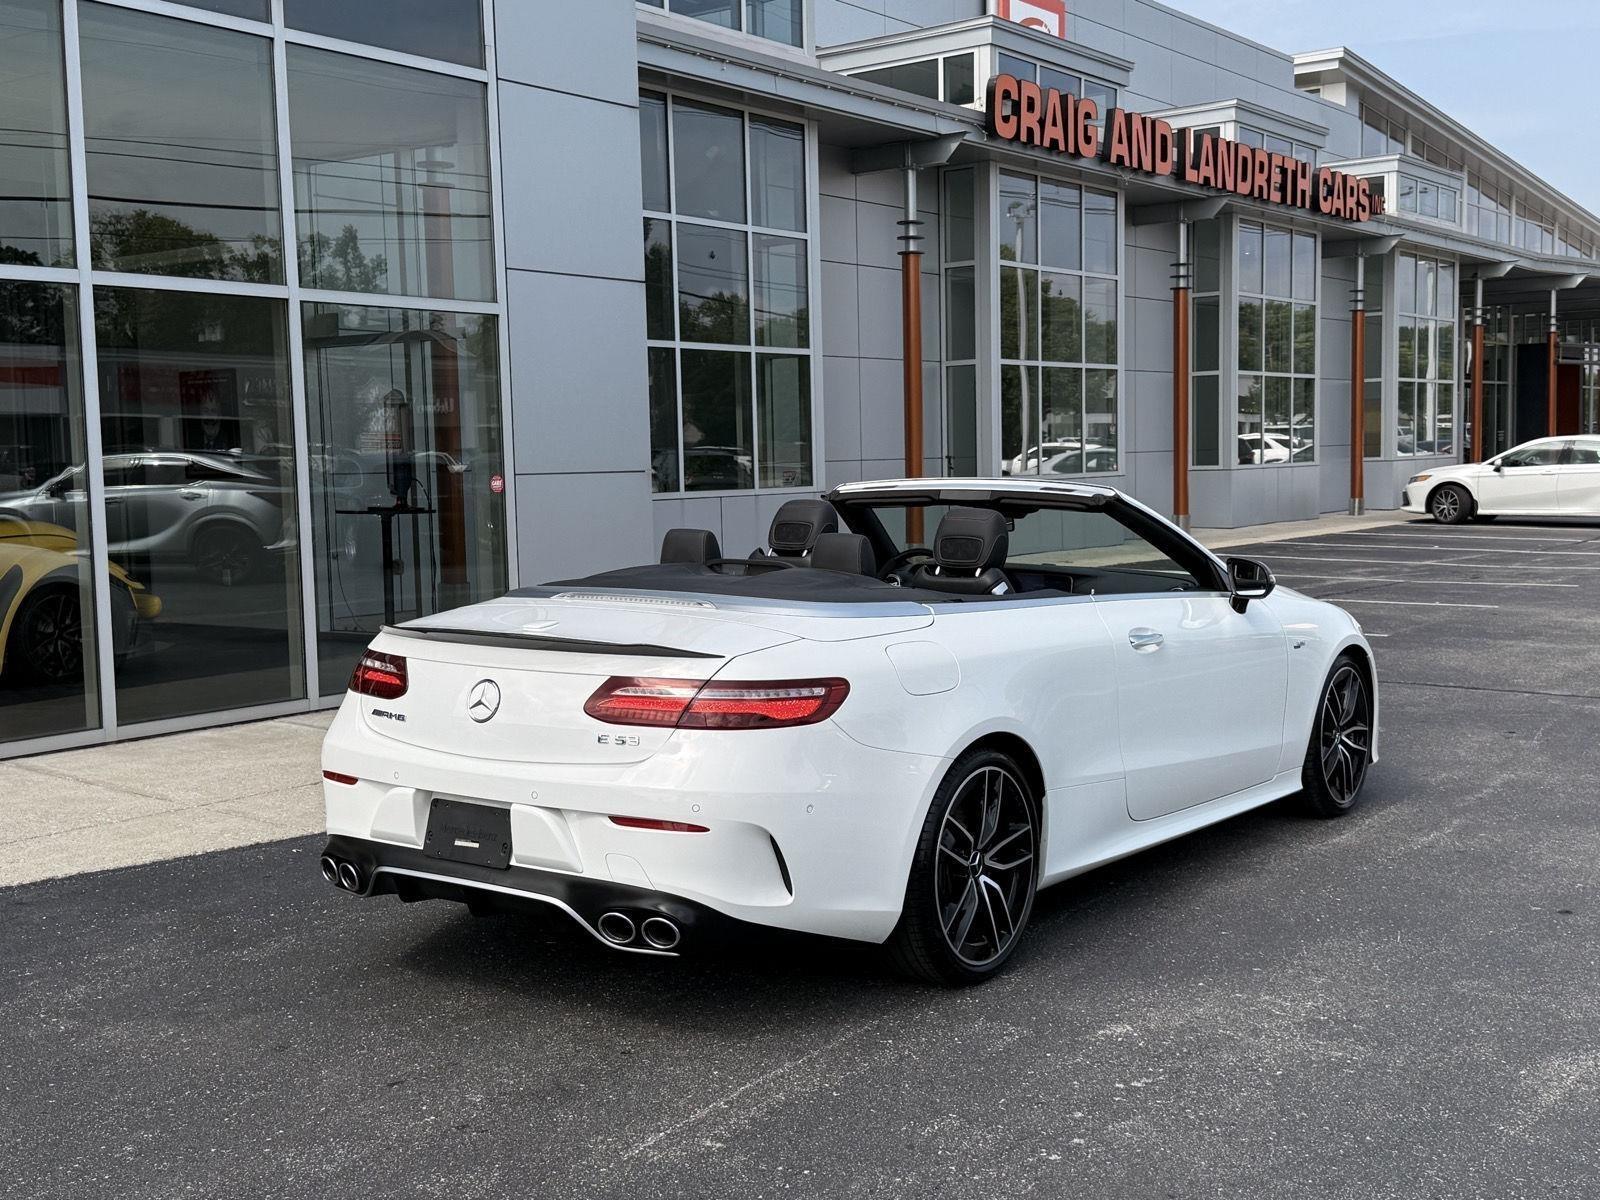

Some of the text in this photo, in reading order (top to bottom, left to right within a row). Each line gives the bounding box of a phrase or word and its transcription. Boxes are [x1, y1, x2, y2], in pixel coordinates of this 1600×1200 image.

[990, 74, 1098, 158] CRAIG
[1108, 107, 1174, 176] AND
[1184, 127, 1311, 209] LANDRETH
[1315, 167, 1371, 222] CARS
[377, 709, 406, 722] AMG
[597, 733, 640, 747] E 53
